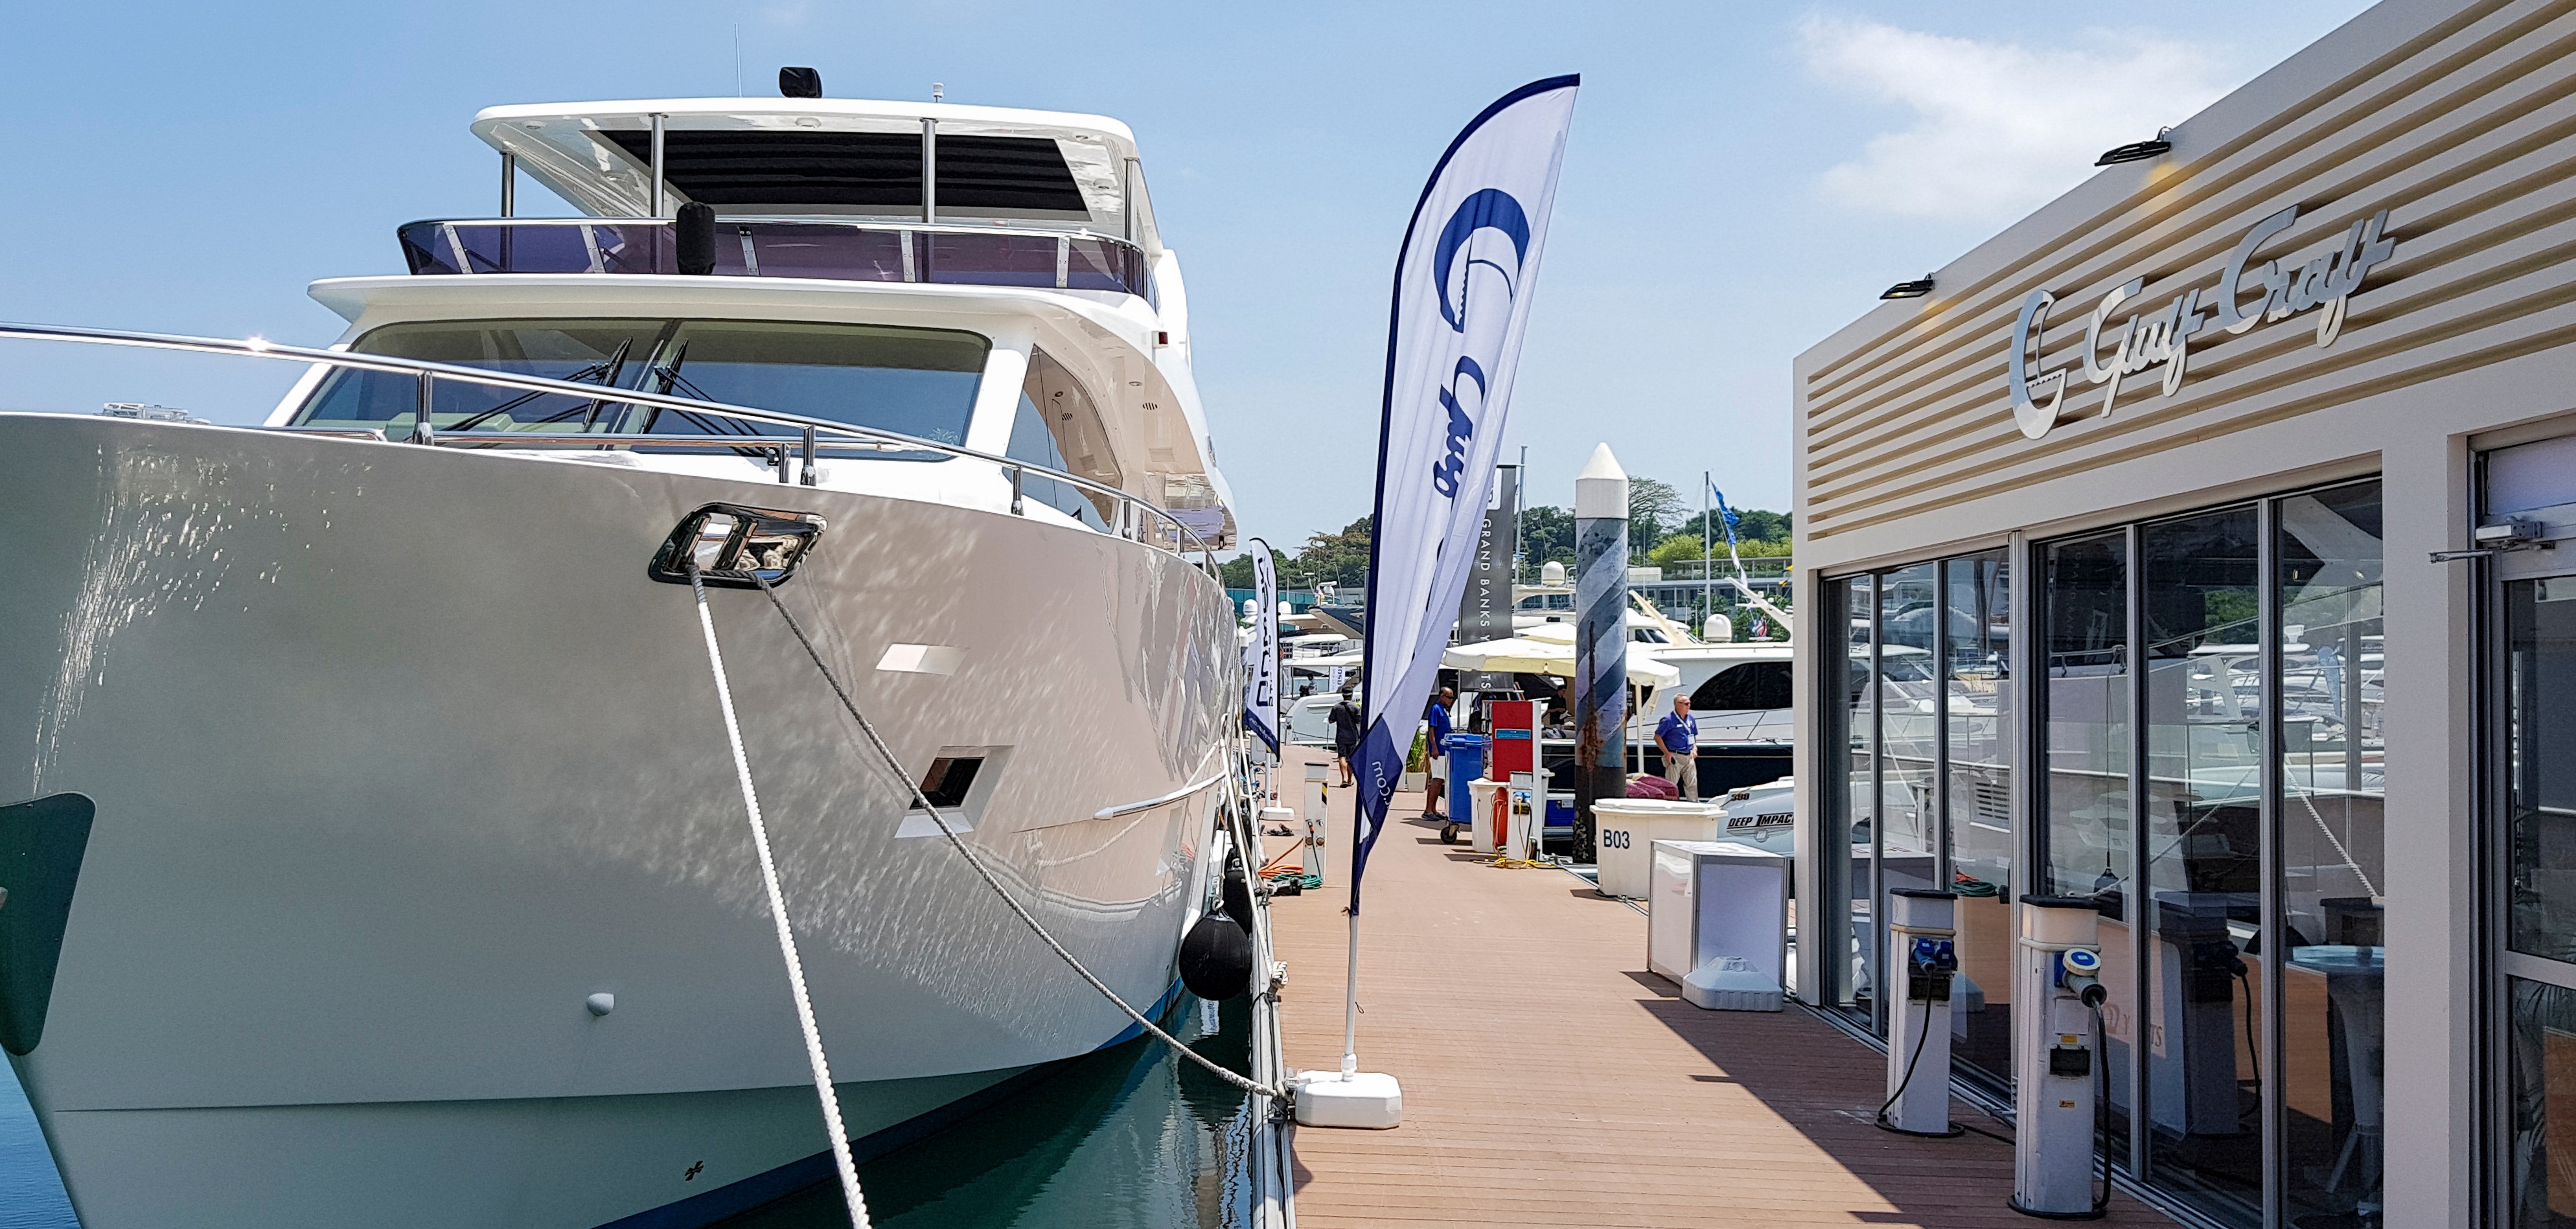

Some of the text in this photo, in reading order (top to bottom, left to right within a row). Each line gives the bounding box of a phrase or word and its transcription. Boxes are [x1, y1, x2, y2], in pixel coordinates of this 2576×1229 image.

[2082, 204, 2397, 419] Gulf Craft
[1480, 518, 1491, 689] GRAND BANKS YTS
[1603, 829, 1630, 849] B03
[1727, 812, 1794, 827] DEEP IMPAC
